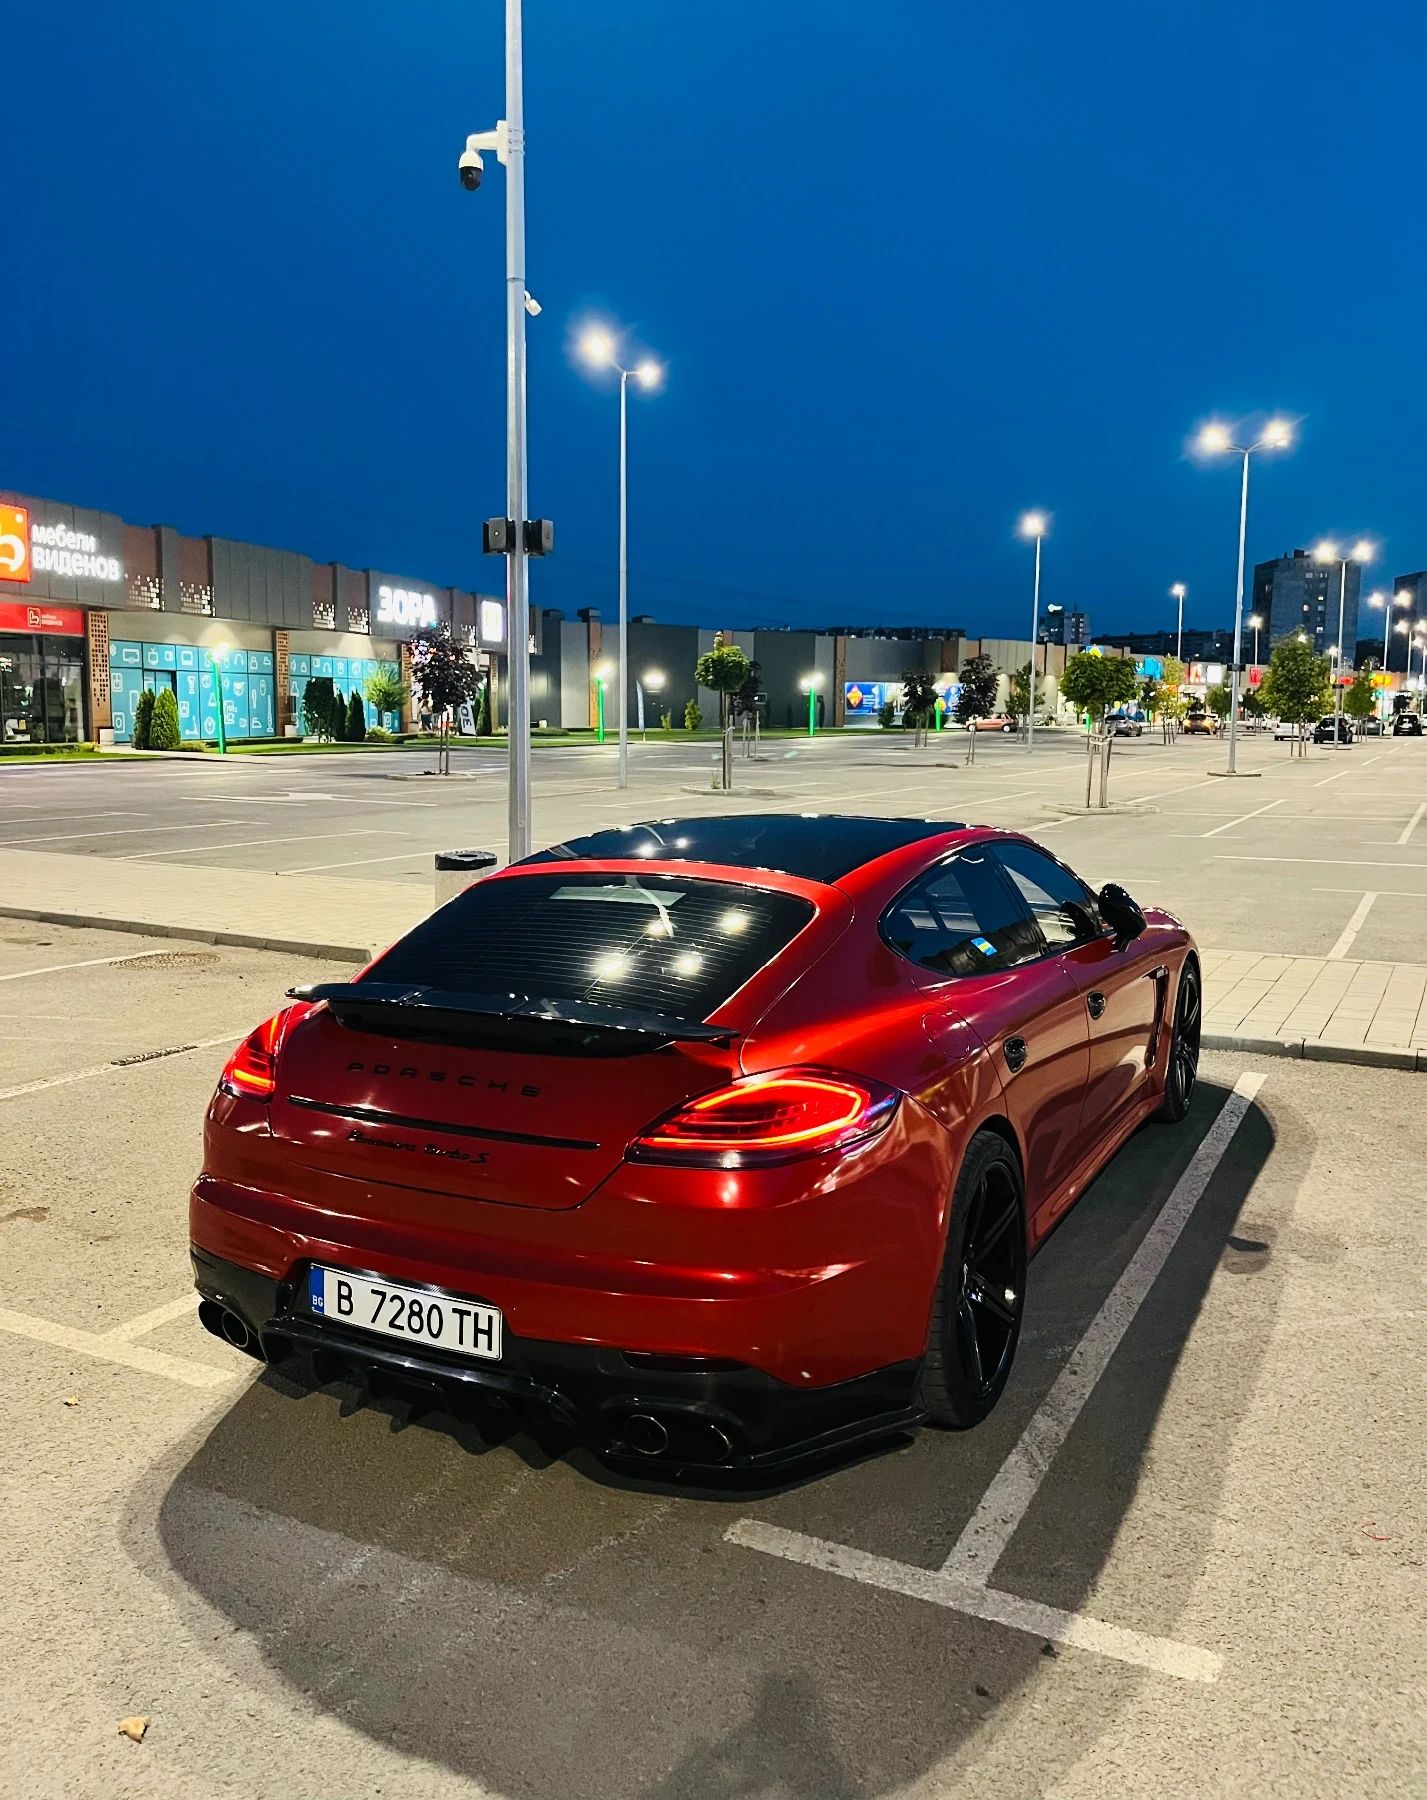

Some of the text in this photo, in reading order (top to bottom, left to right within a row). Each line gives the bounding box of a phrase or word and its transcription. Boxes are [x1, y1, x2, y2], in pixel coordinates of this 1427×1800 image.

[32, 523, 97, 553] мебели
[346, 1061, 542, 1098] PORSCHE
[424, 1143, 470, 1161] Turbo
[468, 1152, 490, 1164] S
[312, 1294, 324, 1308] BG
[337, 1279, 494, 1352] B 7280 TH
